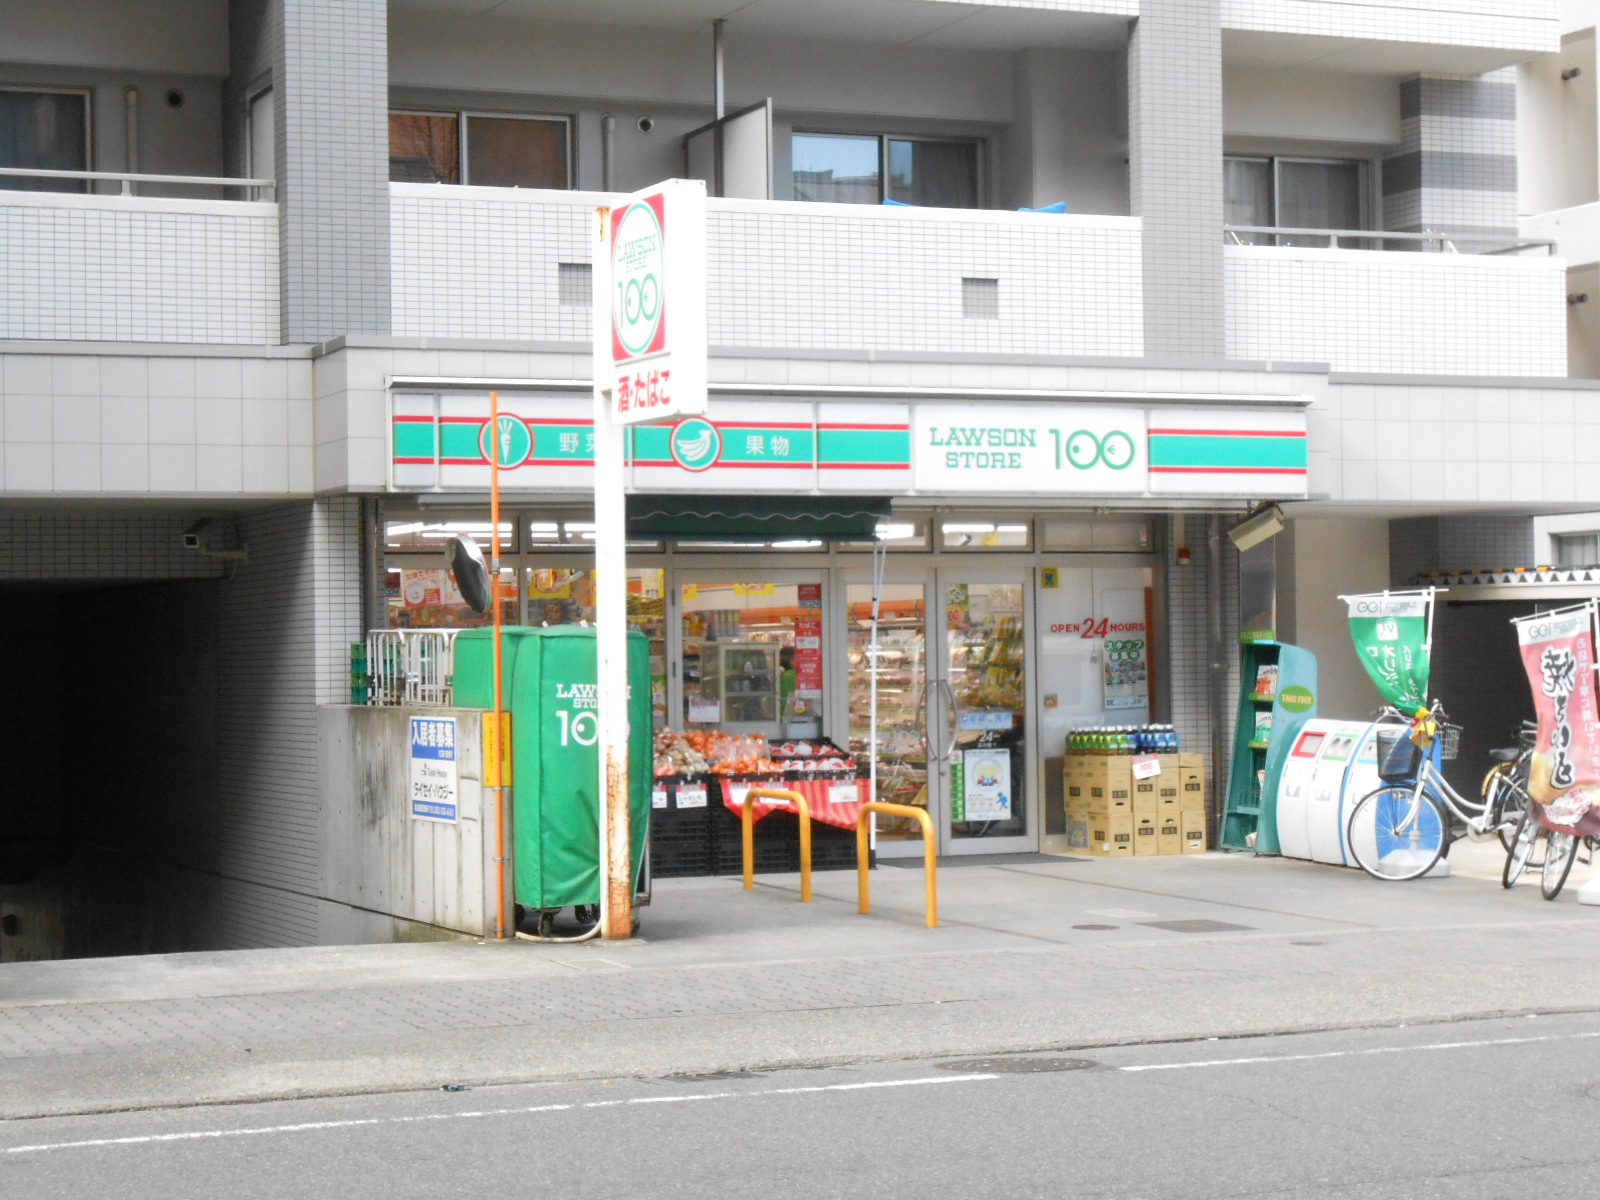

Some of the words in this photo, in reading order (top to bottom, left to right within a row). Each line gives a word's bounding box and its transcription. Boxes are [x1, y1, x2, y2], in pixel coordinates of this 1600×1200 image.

[617, 234, 656, 262] LAWSON
[618, 273, 658, 329] 100
[618, 370, 671, 413] 酒・たばこ
[746, 435, 791, 456] 果物
[930, 427, 1037, 447] LAWSON
[945, 451, 1022, 469] STORE
[1049, 428, 1136, 470] 100
[1050, 623, 1080, 633] OPEN
[1081, 617, 1110, 639] 24
[1110, 622, 1146, 632] HOURS
[1105, 640, 1144, 650] スタッフ
[573, 698, 599, 709] STO
[412, 720, 454, 748] 入居者募集
